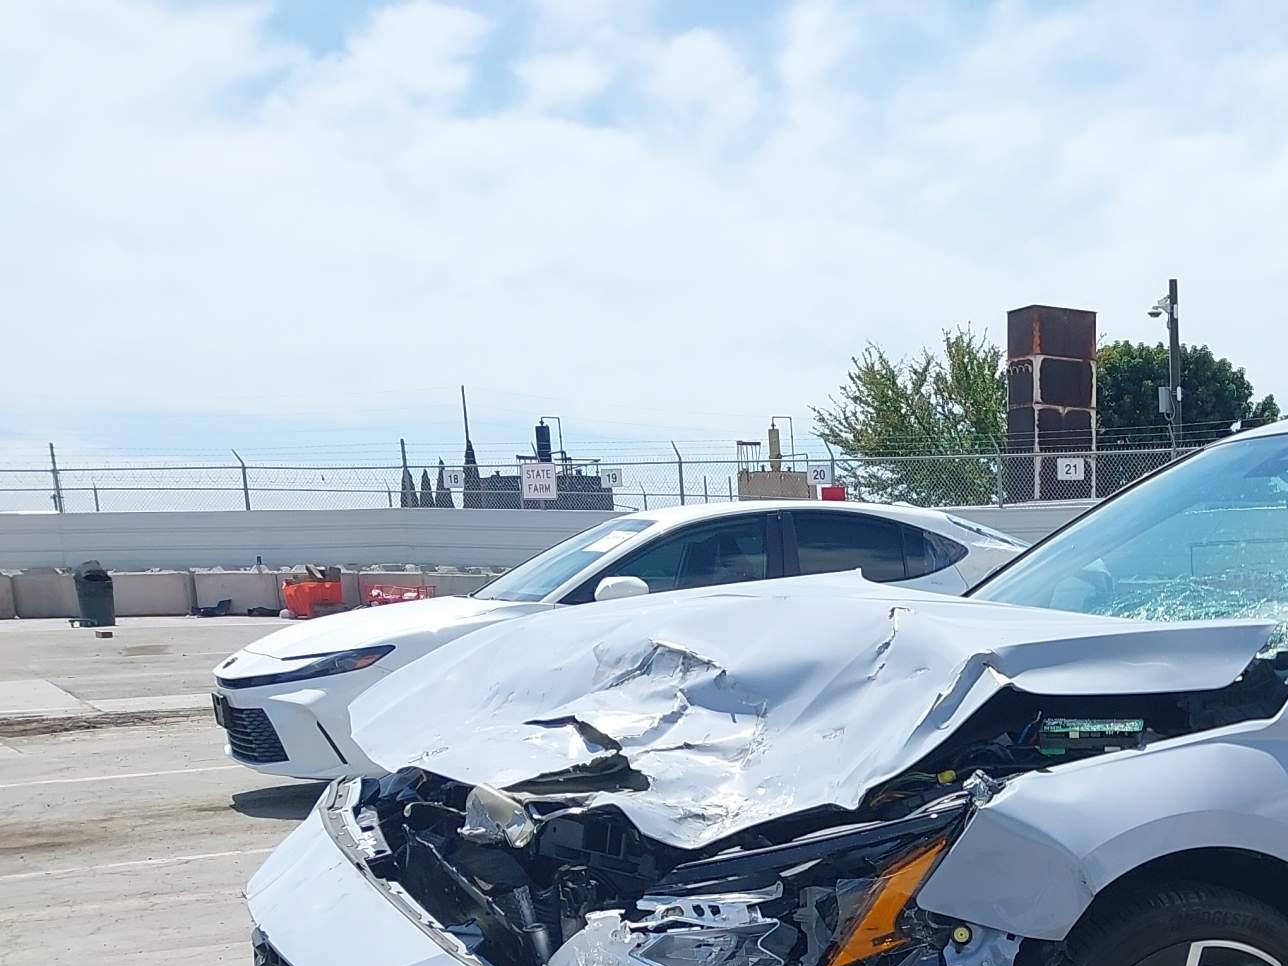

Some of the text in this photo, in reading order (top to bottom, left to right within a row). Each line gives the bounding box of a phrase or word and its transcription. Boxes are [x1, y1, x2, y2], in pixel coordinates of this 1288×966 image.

[526, 469, 551, 480] STATE
[812, 469, 826, 480] 20
[1064, 463, 1077, 475] 21
[447, 474, 459, 484] 18
[606, 472, 618, 483] 19
[528, 483, 551, 493] FARM
